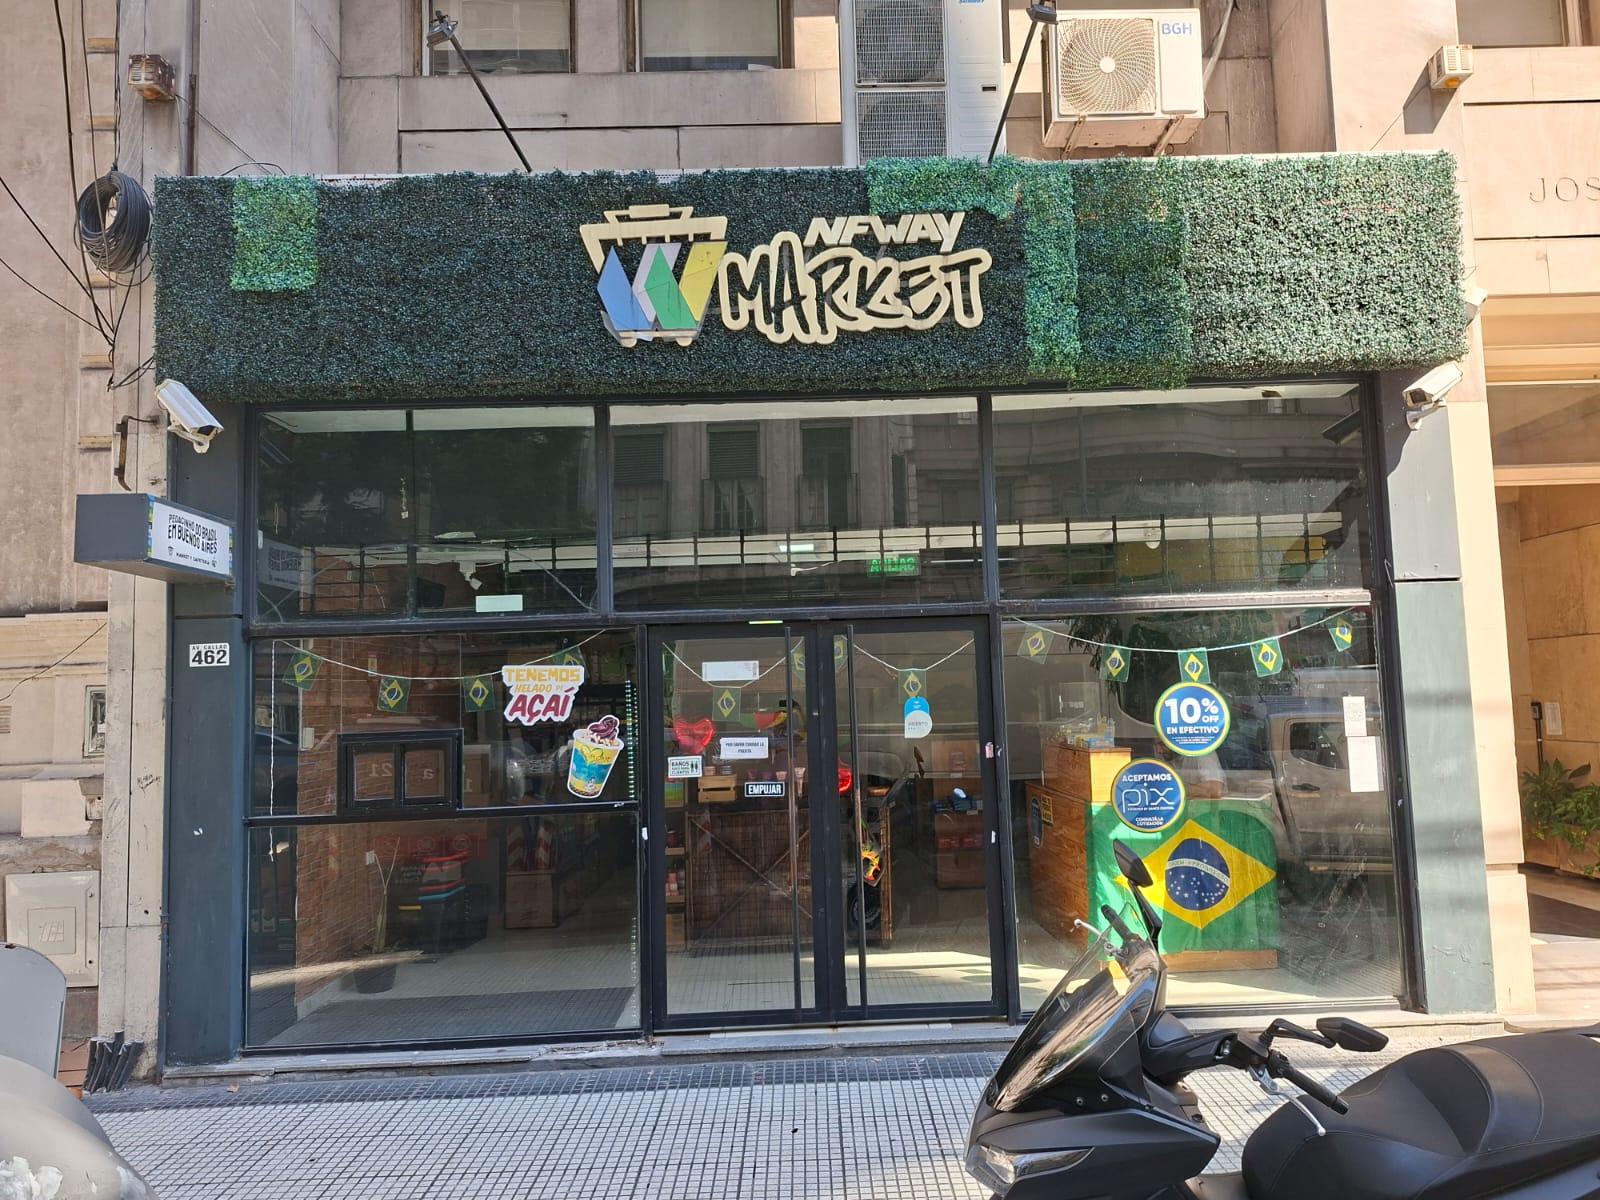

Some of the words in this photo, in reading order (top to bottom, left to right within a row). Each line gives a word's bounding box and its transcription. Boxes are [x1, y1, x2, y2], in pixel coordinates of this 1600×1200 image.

[1162, 23, 1192, 35] BGH
[719, 231, 993, 344] MARKET
[177, 525, 200, 550] BUENOS
[192, 650, 228, 665] 462
[505, 668, 580, 682] TENEMOS
[515, 683, 552, 693] HELADO
[509, 686, 575, 722] AÇAÍ
[1201, 715, 1219, 723] OFF
[1166, 726, 1178, 735] EN
[1179, 725, 1220, 734] EFECTIVO
[1122, 773, 1172, 782] ACEPTAMOS
[748, 784, 782, 795] EMPUJAR
